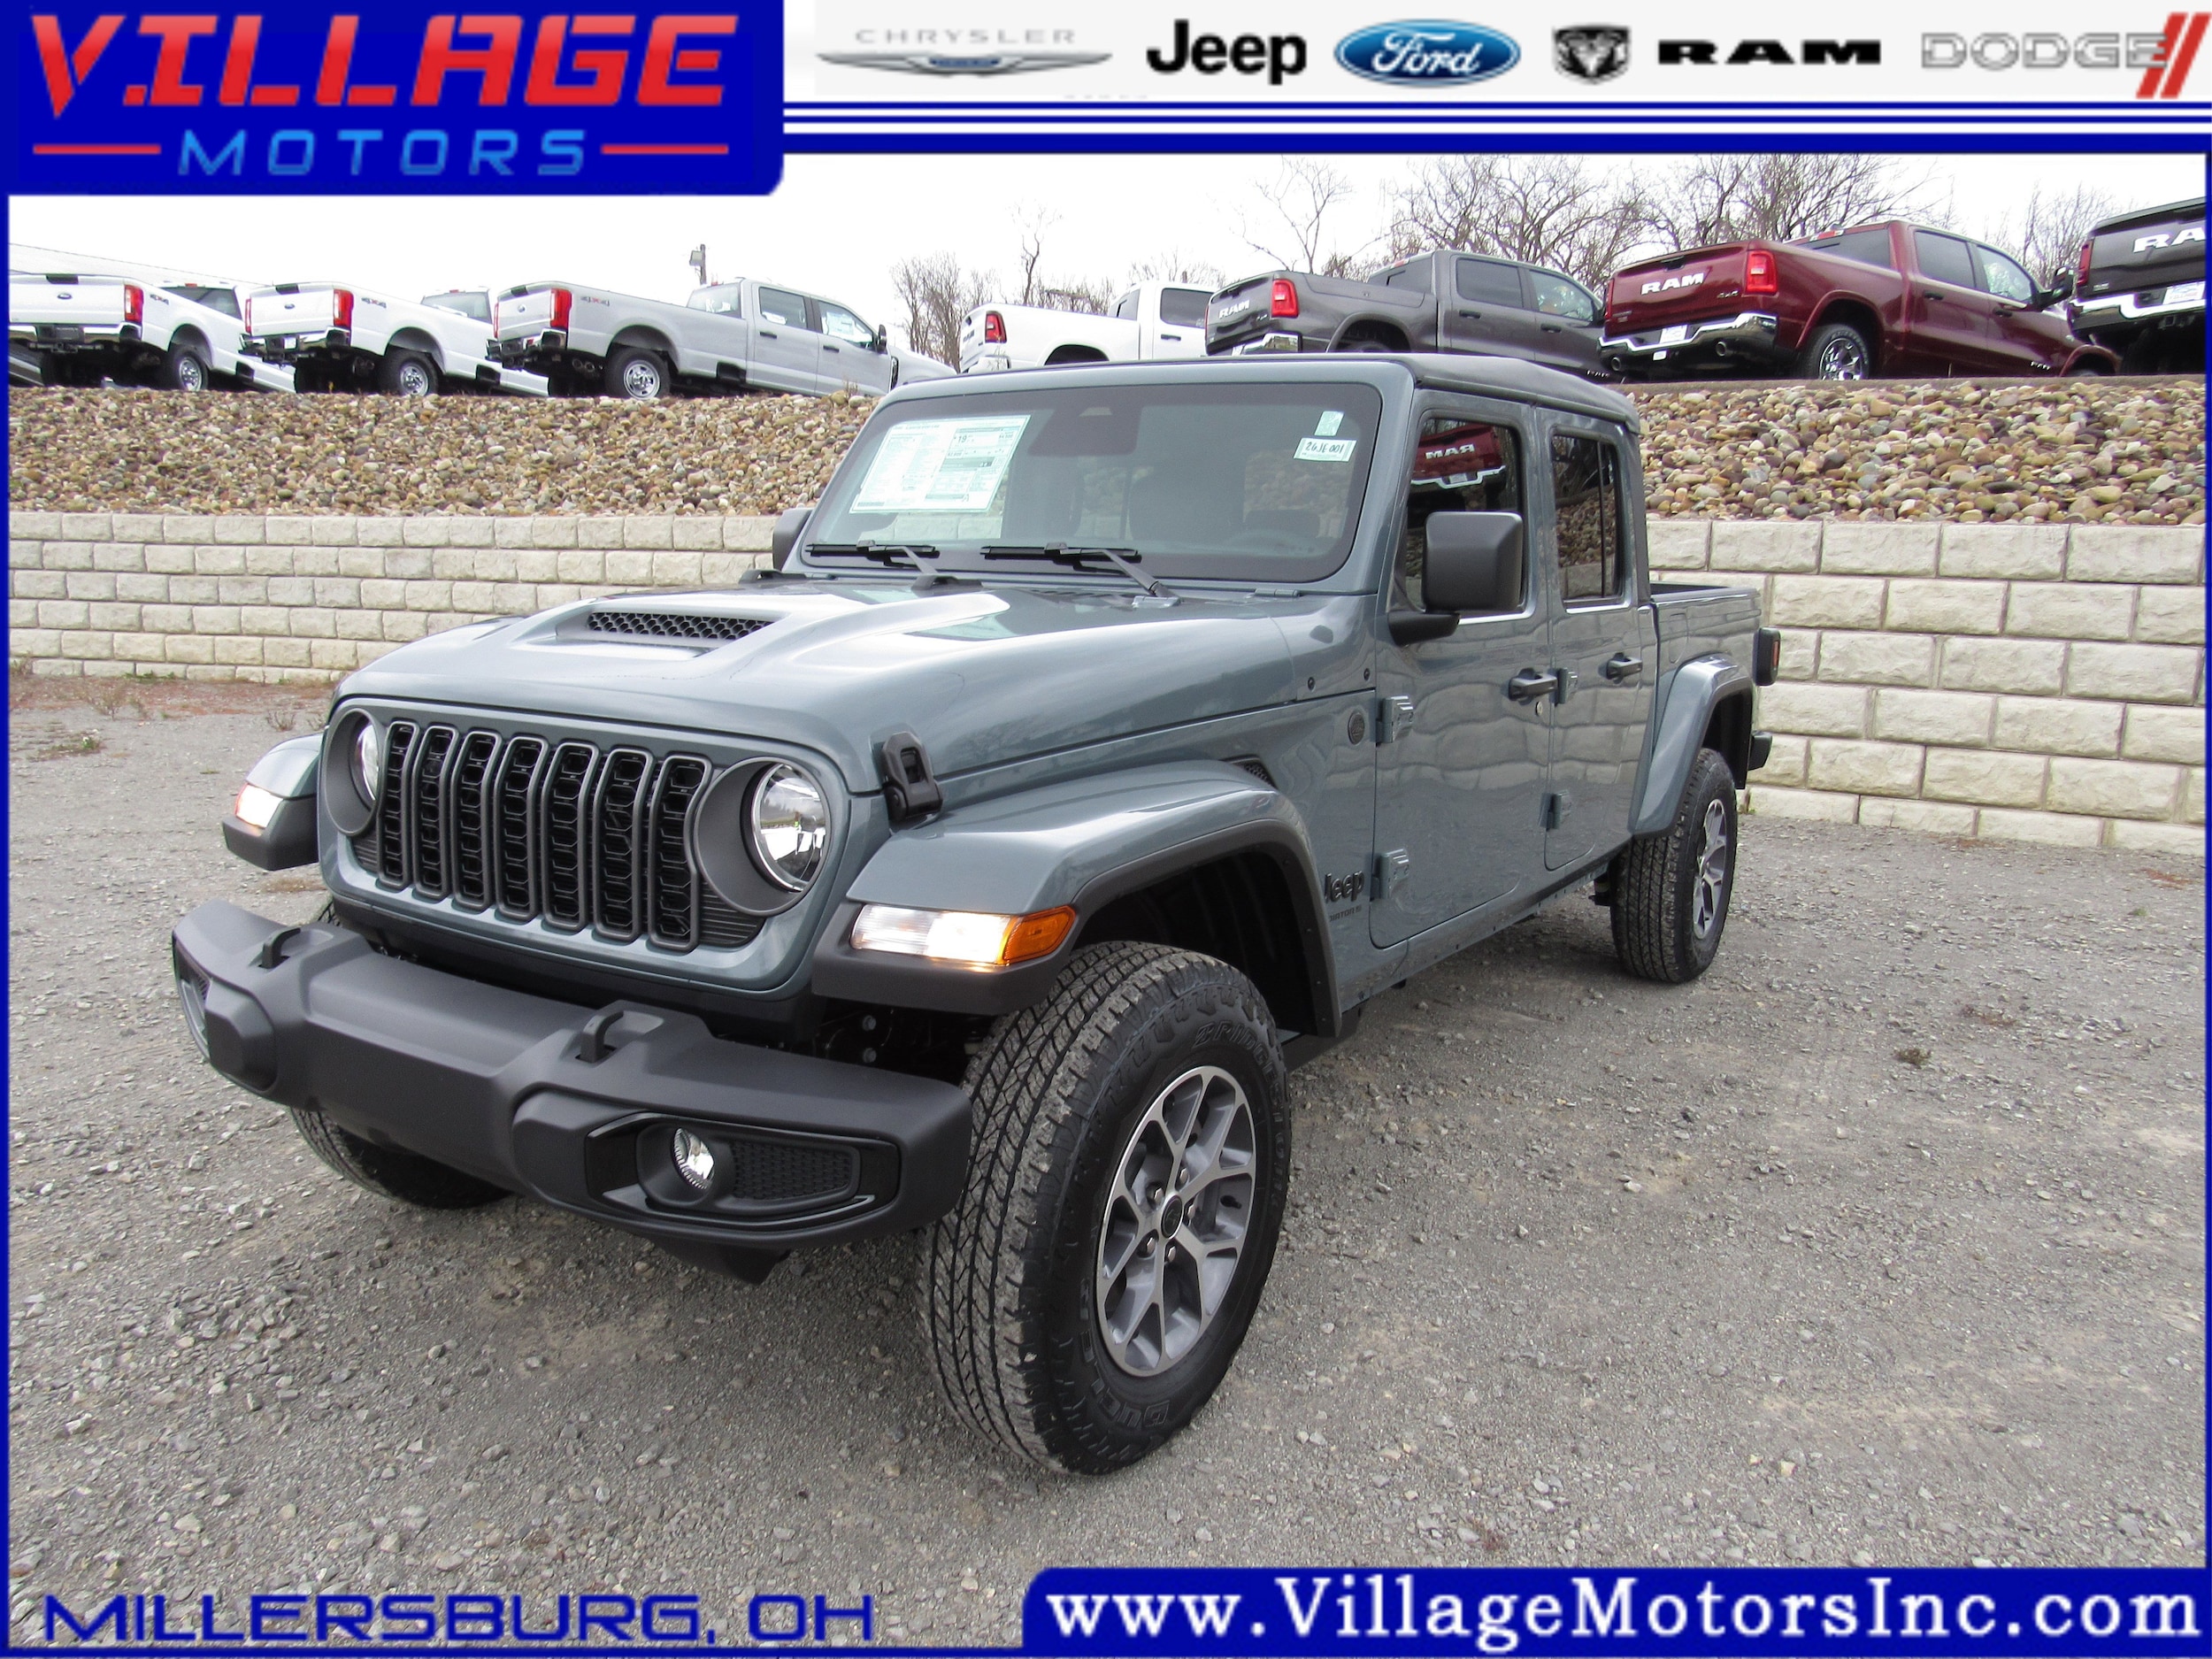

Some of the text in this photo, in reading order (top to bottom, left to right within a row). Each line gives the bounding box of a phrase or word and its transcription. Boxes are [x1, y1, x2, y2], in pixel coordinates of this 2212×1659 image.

[2132, 227, 2206, 253] RA
[1640, 273, 1704, 295] RAM
[1218, 299, 1250, 319] RAM
[1324, 871, 1365, 903] Jeep
